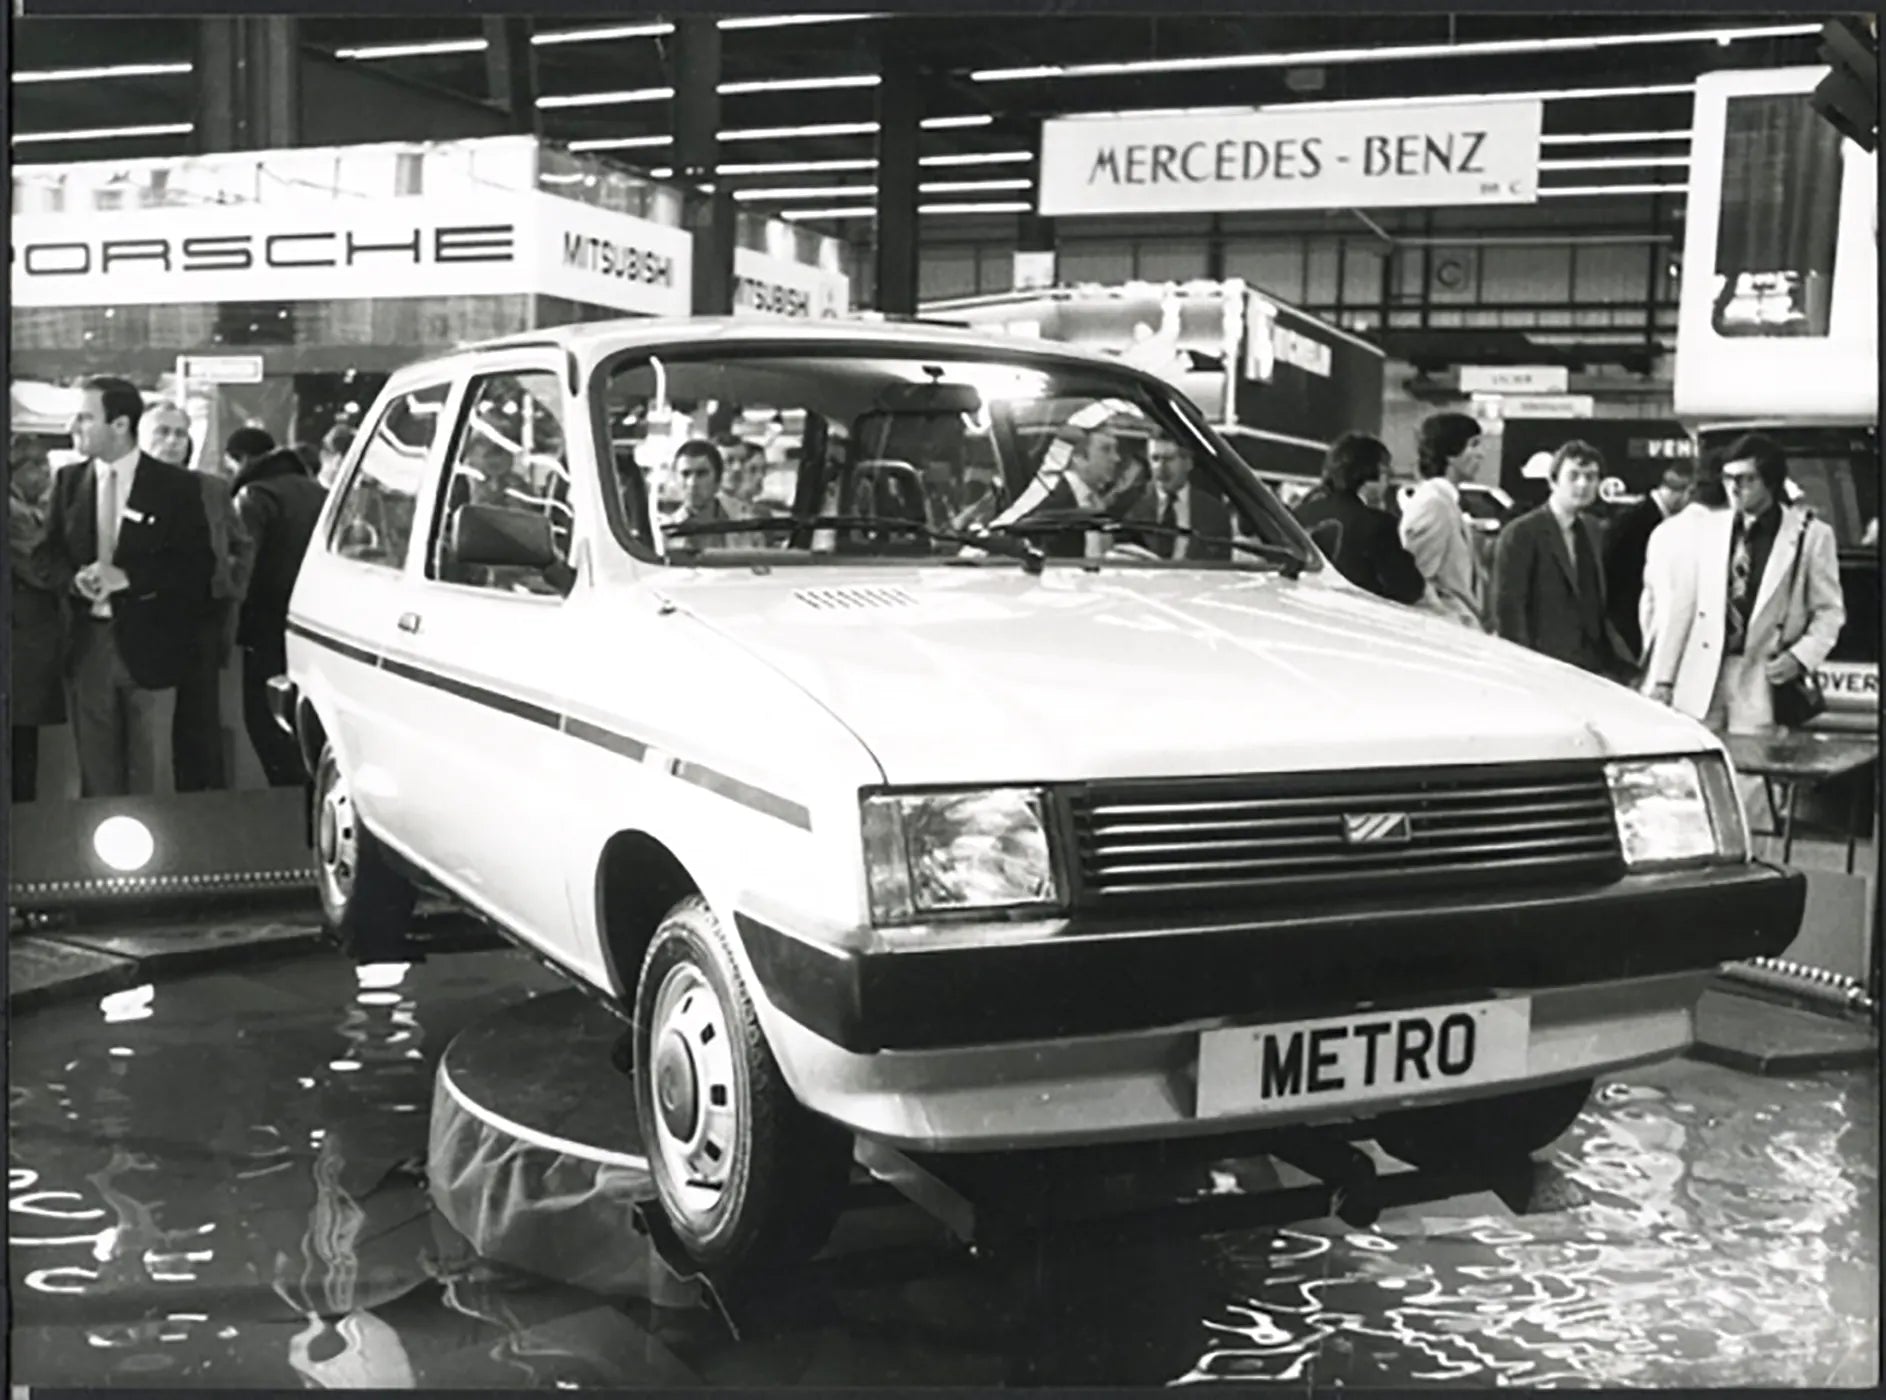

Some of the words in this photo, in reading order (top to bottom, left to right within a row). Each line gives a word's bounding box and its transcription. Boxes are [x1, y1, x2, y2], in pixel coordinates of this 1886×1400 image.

[1364, 131, 1487, 177] BENZ
[11, 223, 514, 276] ORSCHE
[563, 230, 673, 288] MITSUBISHI
[1261, 1012, 1475, 1100] METRO
